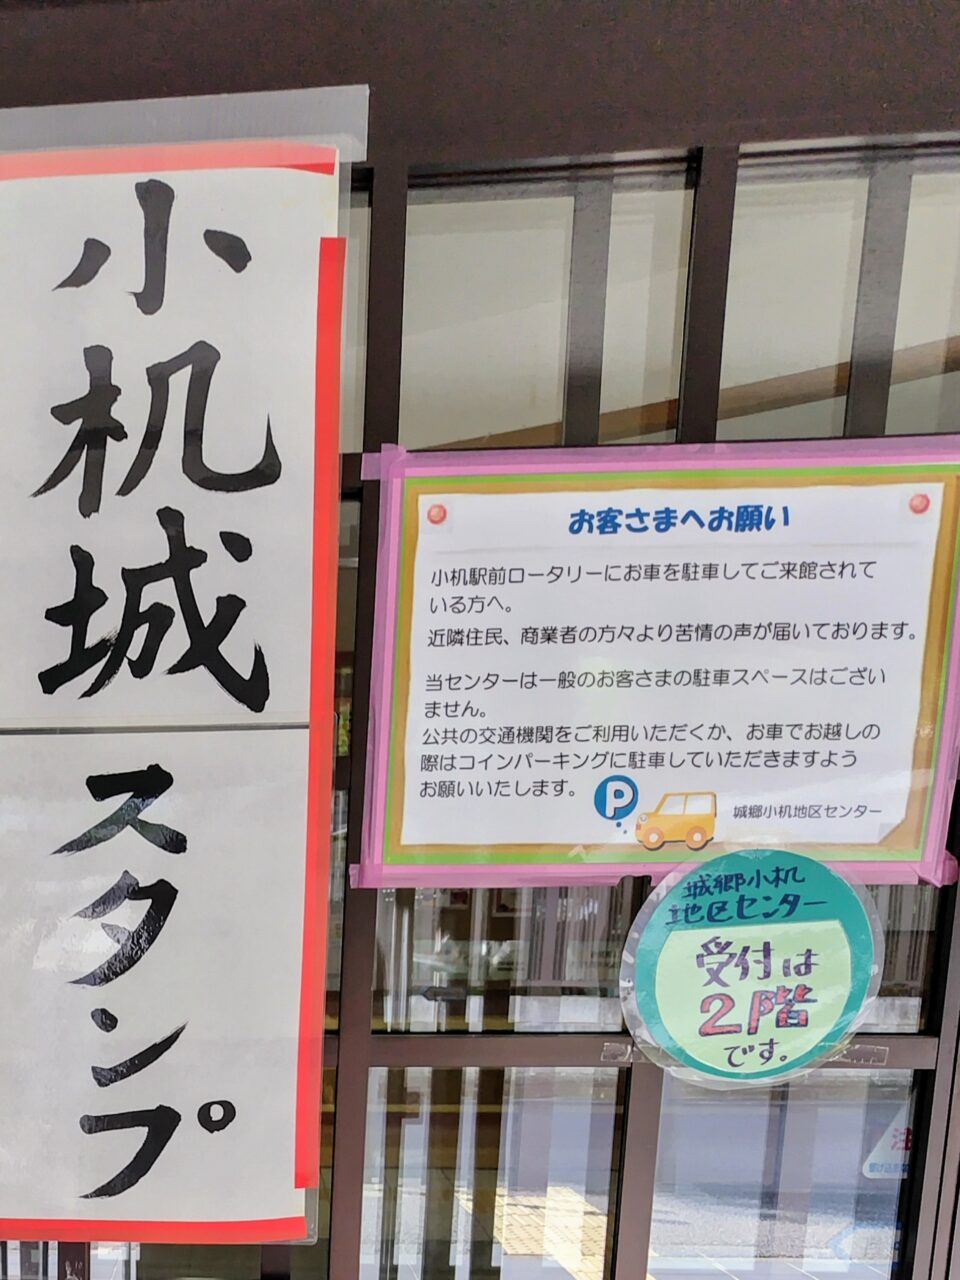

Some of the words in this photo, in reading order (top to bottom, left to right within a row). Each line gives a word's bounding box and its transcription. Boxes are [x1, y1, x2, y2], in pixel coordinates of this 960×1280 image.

[27, 178, 281, 713] 小机城
[568, 504, 791, 535] お客さまへお願い
[431, 559, 877, 586] 小机駅前ロータリーにお車を駐車してご来館されて
[430, 595, 513, 615] いる方へ。
[428, 620, 917, 648] 近隣住民、商業者の方々より苦情の声が届いております。
[425, 667, 886, 693] 当センターは一般のお客さまの駐車スペースはござい
[424, 700, 487, 719] ません。
[422, 721, 880, 745] 公共の交通機関をご利用いただくか、お車でお越しの
[420, 749, 858, 771] 際はコインパーキングに駐車していただきますよう
[419, 778, 576, 799] お願いいたします。
[732, 804, 882, 819] 城郷小机地区センター
[681, 865, 806, 900] 城郷小机
[665, 893, 830, 926] 地区センター
[696, 935, 819, 988] 受付は
[50, 763, 235, 1199] スタンプ
[698, 983, 818, 1037] 2階
[723, 1037, 788, 1068] です。
